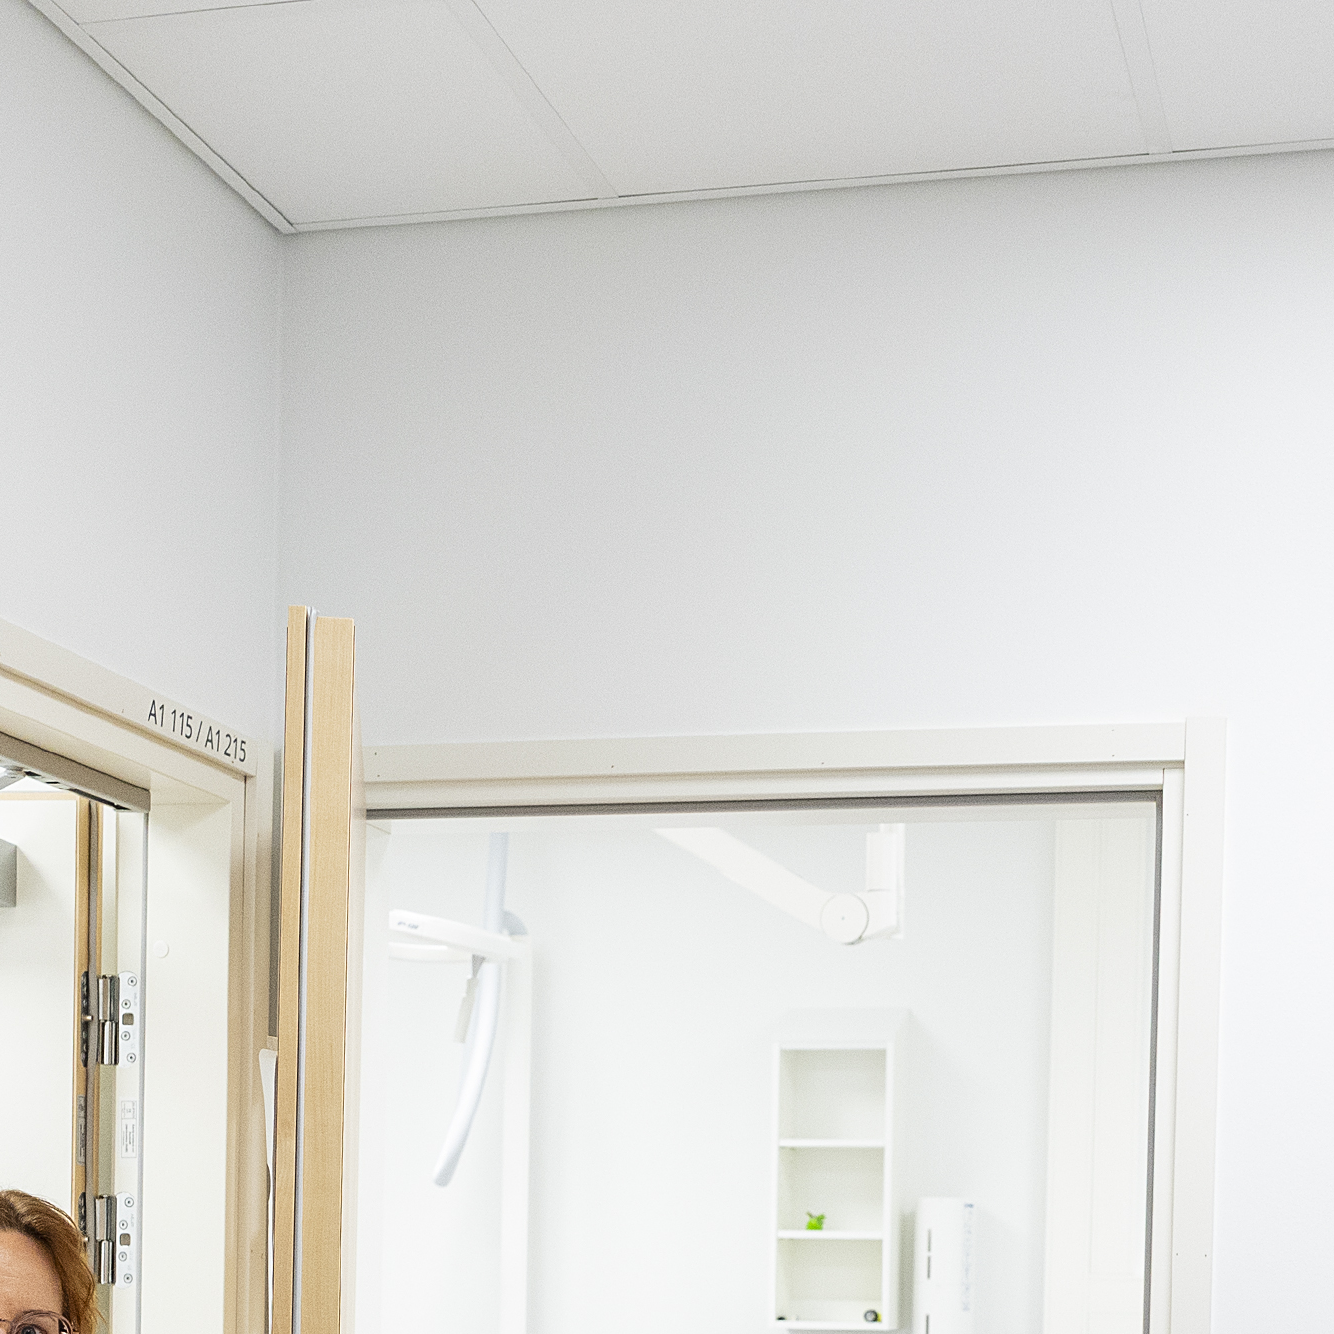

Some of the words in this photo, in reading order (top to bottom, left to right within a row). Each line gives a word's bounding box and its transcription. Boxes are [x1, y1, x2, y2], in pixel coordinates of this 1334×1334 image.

[148, 699, 165, 727] A1
[171, 709, 193, 739] 115
[196, 721, 203, 742] /
[205, 726, 221, 752] A1
[224, 733, 247, 762] 215
